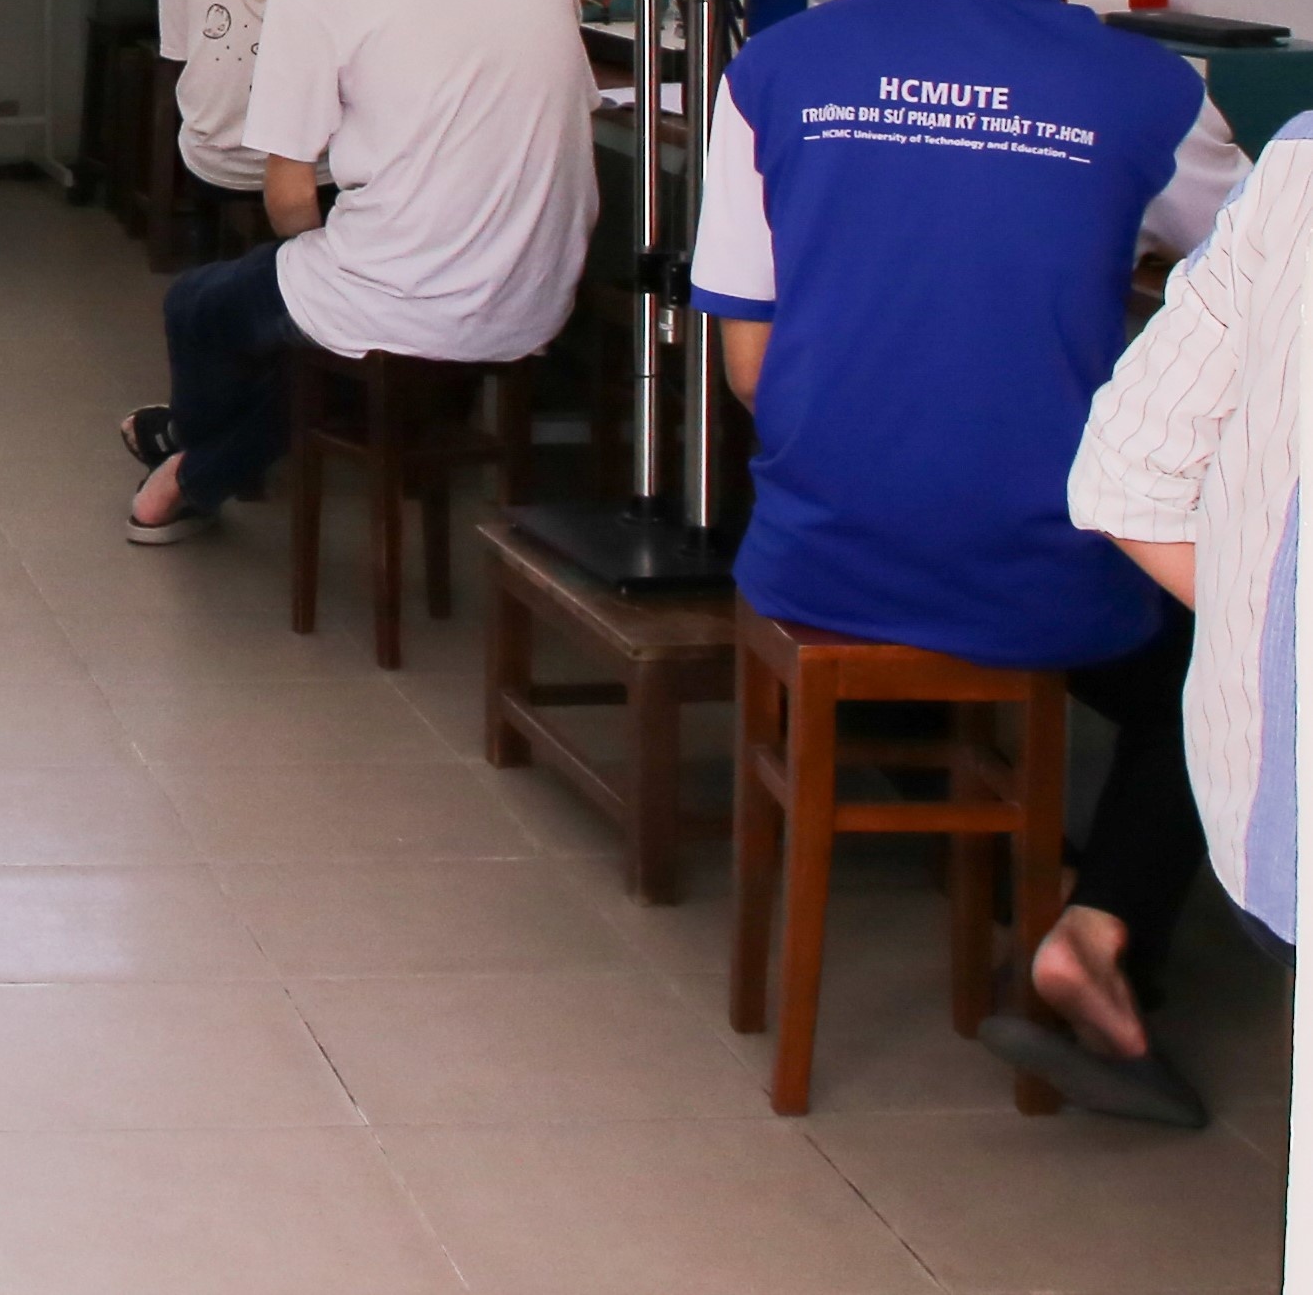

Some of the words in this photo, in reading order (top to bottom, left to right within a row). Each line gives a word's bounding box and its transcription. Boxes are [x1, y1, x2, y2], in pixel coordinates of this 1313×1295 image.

[879, 76, 1010, 110] HCMUTE
[858, 107, 880, 123] ĐH
[884, 108, 906, 124] SƯ
[907, 111, 951, 130] PHẠM
[981, 115, 1032, 137] THUẬT
[1035, 122, 1095, 146] TP.HCM
[822, 130, 852, 139] HCMC
[854, 130, 907, 144] University
[909, 134, 921, 143] of
[924, 135, 985, 150] Technology
[987, 141, 1009, 151] and
[1011, 143, 1067, 159] Education
